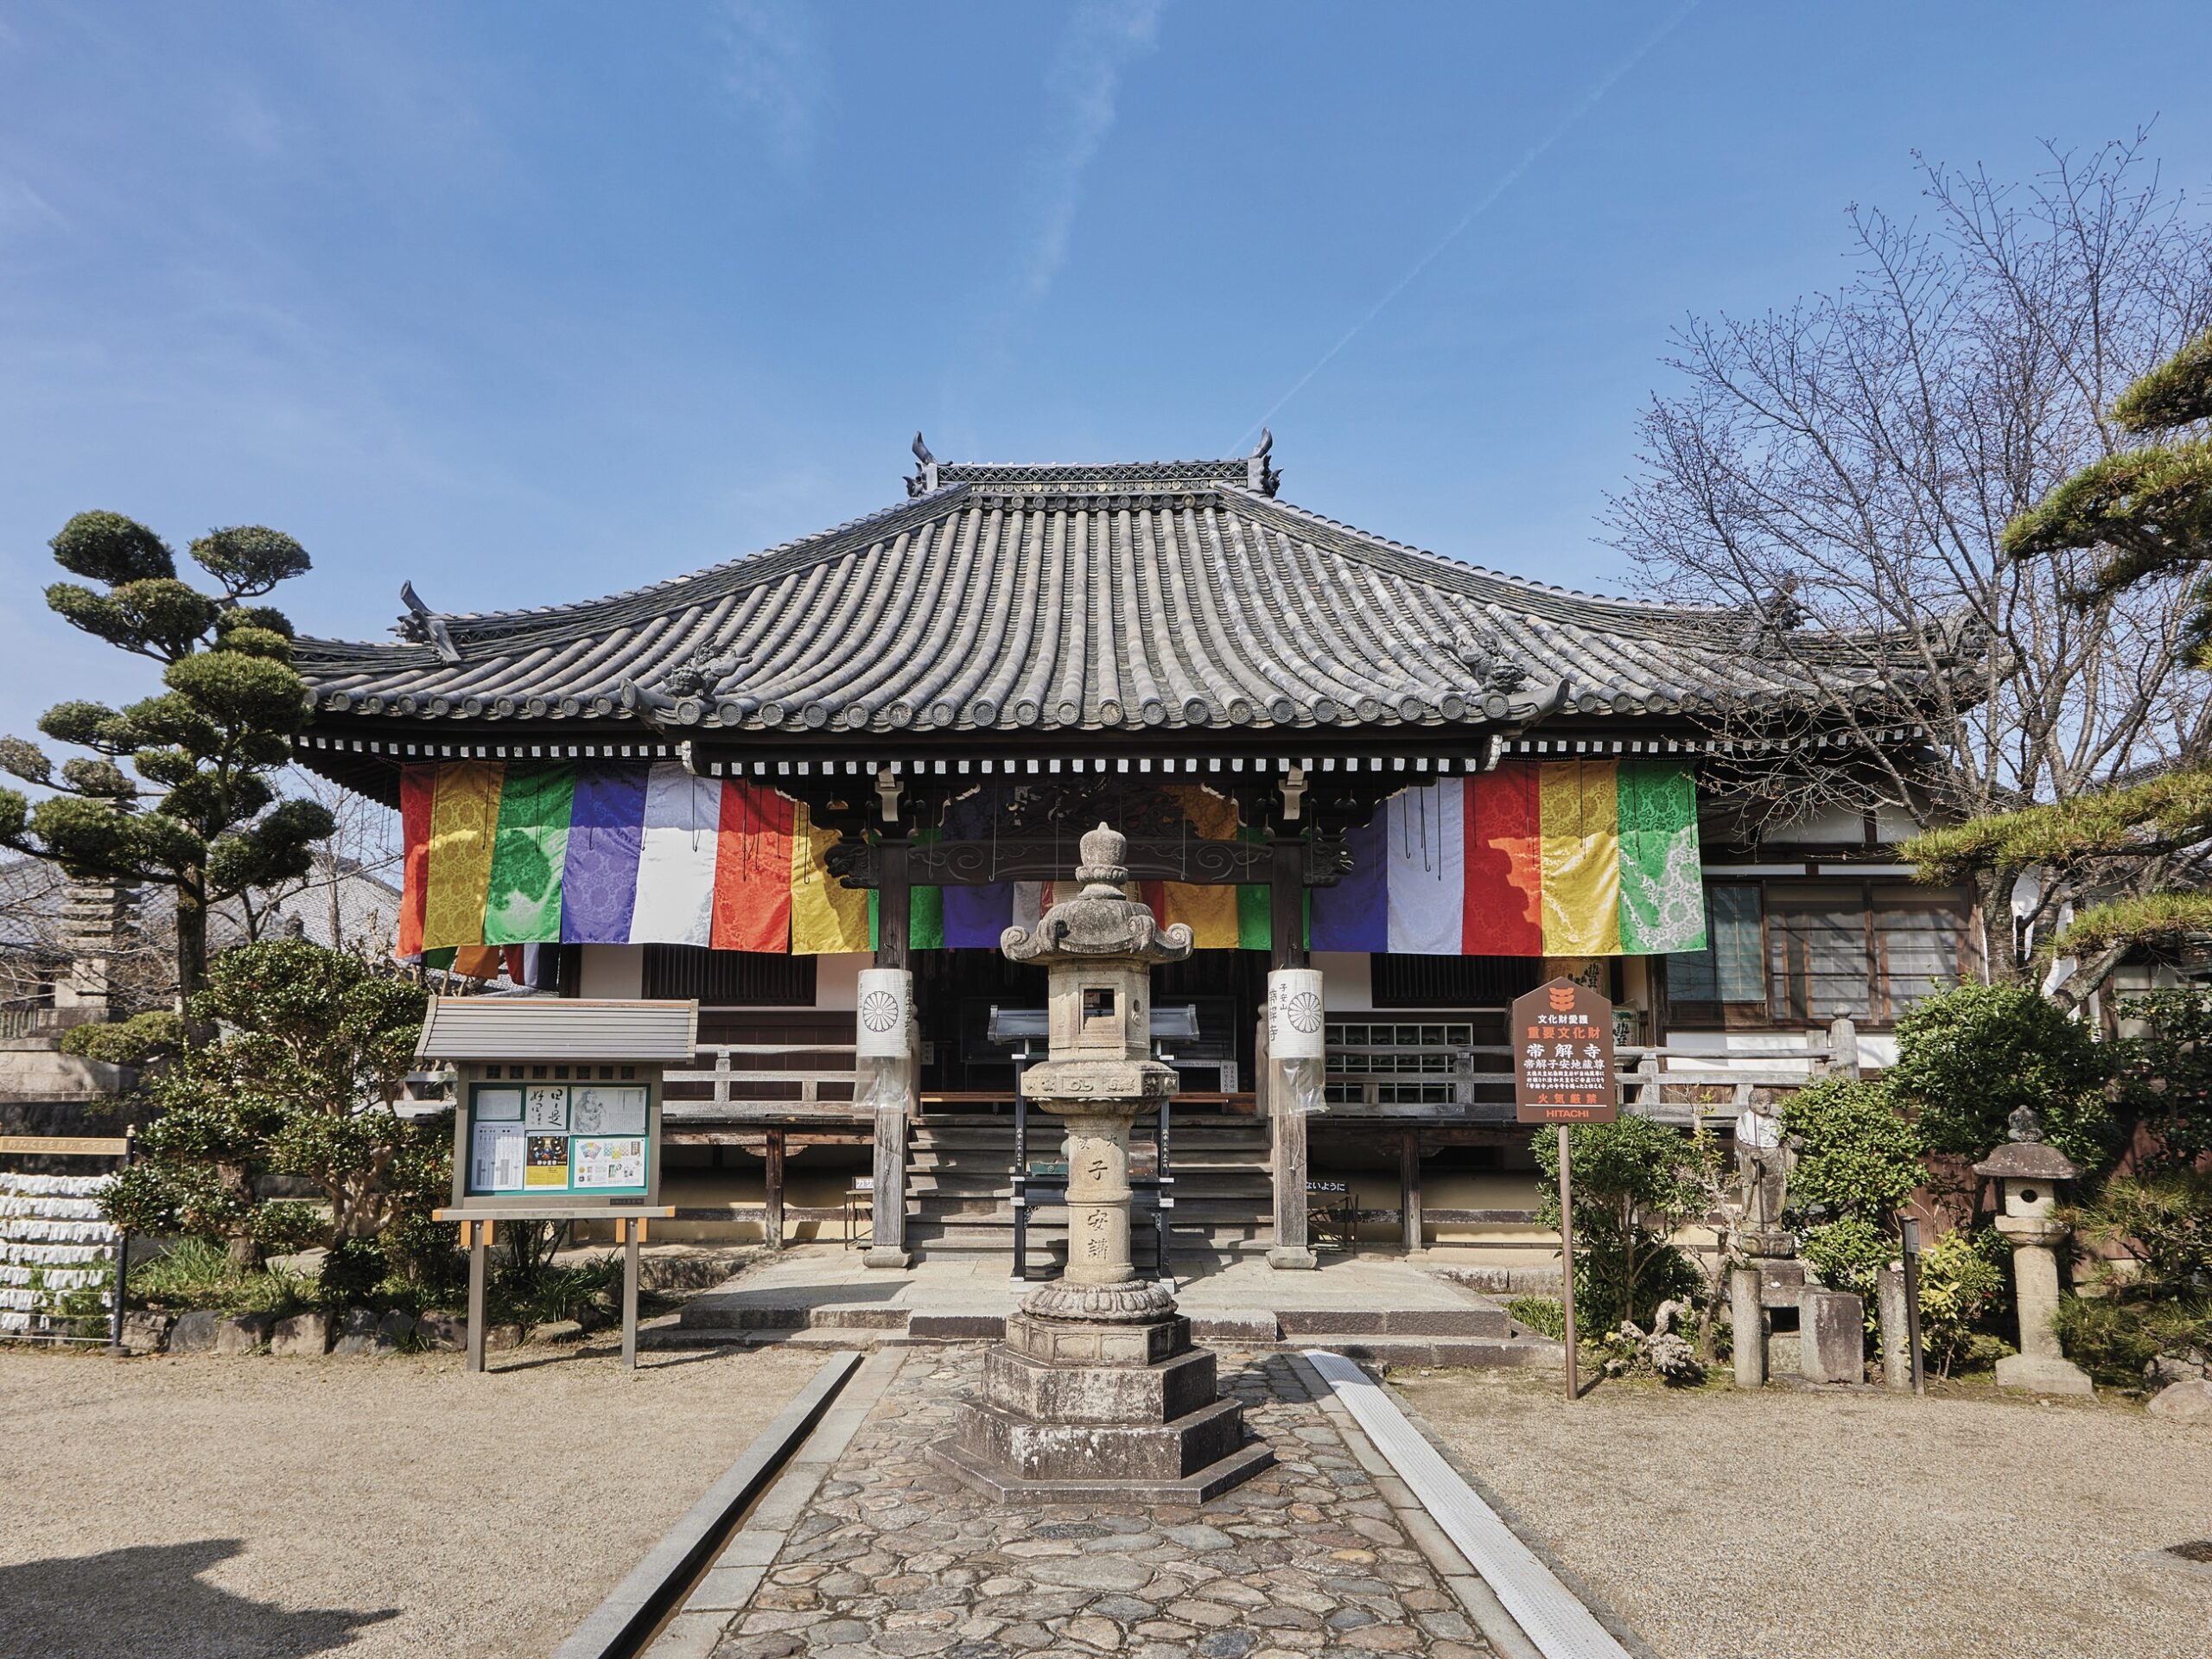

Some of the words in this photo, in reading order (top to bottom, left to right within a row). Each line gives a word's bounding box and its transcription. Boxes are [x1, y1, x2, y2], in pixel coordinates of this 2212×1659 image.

[1279, 983, 1287, 1011] 子安山
[1537, 1014, 1588, 1025] 文化財愛護
[1527, 1027, 1600, 1039] 重要文化財
[1526, 1043, 1601, 1058] 帯解寺
[1523, 1058, 1605, 1070] 帯解子安地蔵尊
[1538, 1092, 1597, 1103] 火気厳禁
[1088, 1160, 1109, 1261] 子安講
